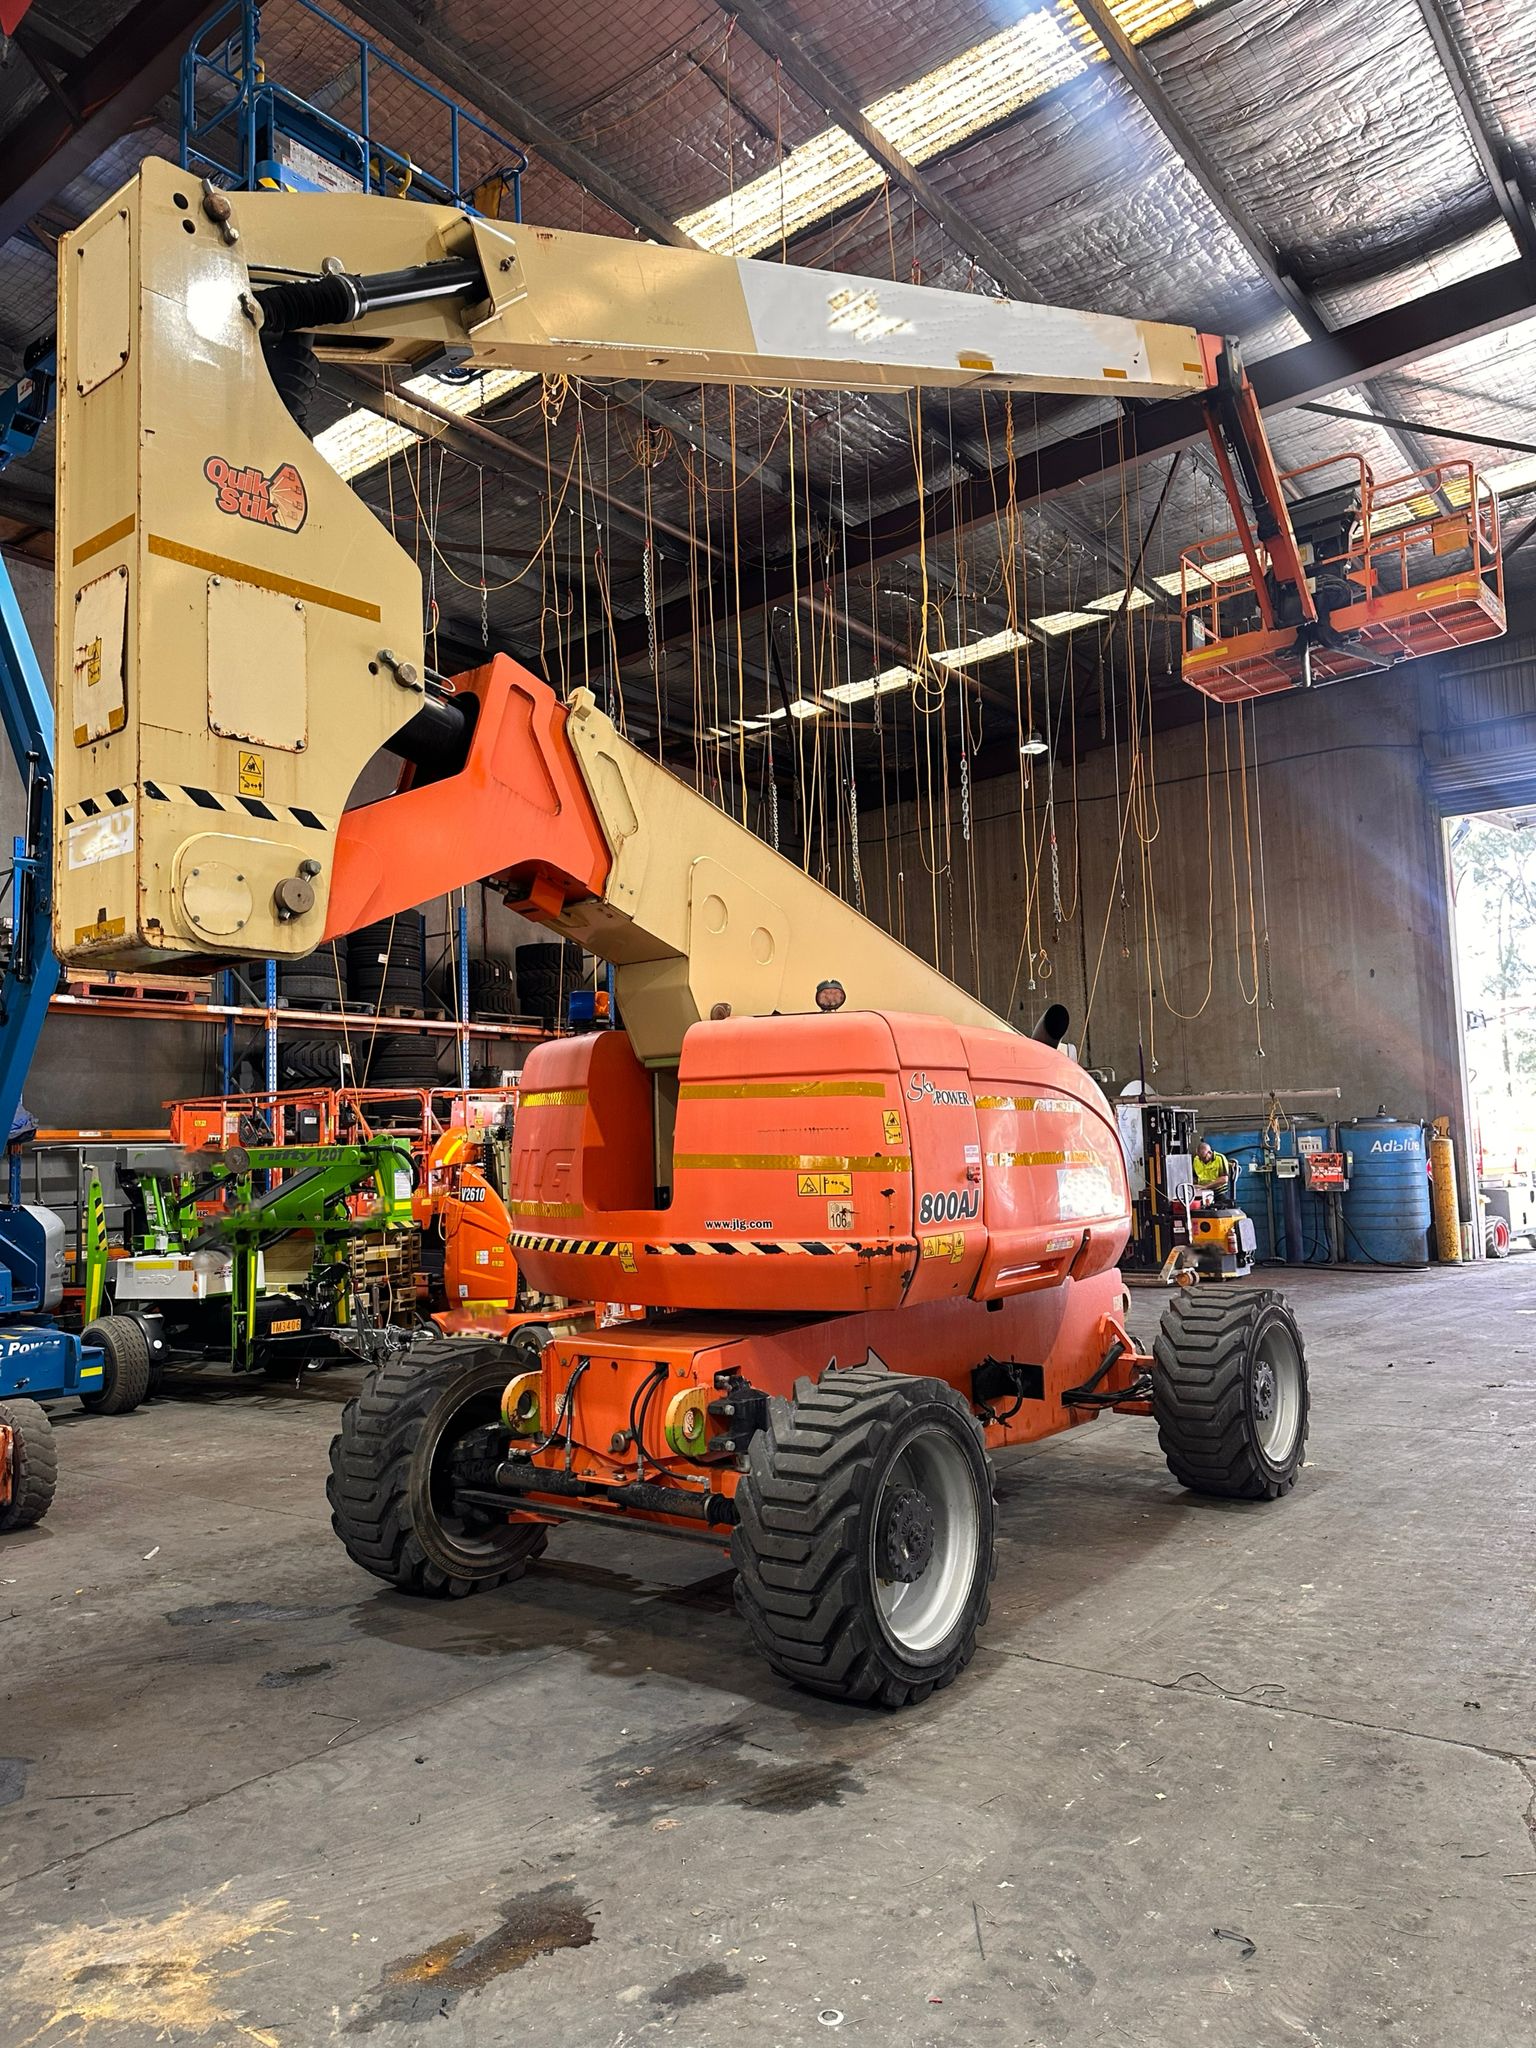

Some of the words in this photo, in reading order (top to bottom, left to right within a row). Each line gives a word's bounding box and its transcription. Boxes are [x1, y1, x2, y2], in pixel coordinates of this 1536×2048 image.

[206, 457, 271, 499] Quik
[219, 487, 277, 524] Stik
[934, 1090, 970, 1105] POWER
[461, 1187, 486, 1202] V2610
[919, 1190, 979, 1224] 800AJ
[705, 1218, 773, 1230] www.jlg.com
[830, 1213, 847, 1228] 106
